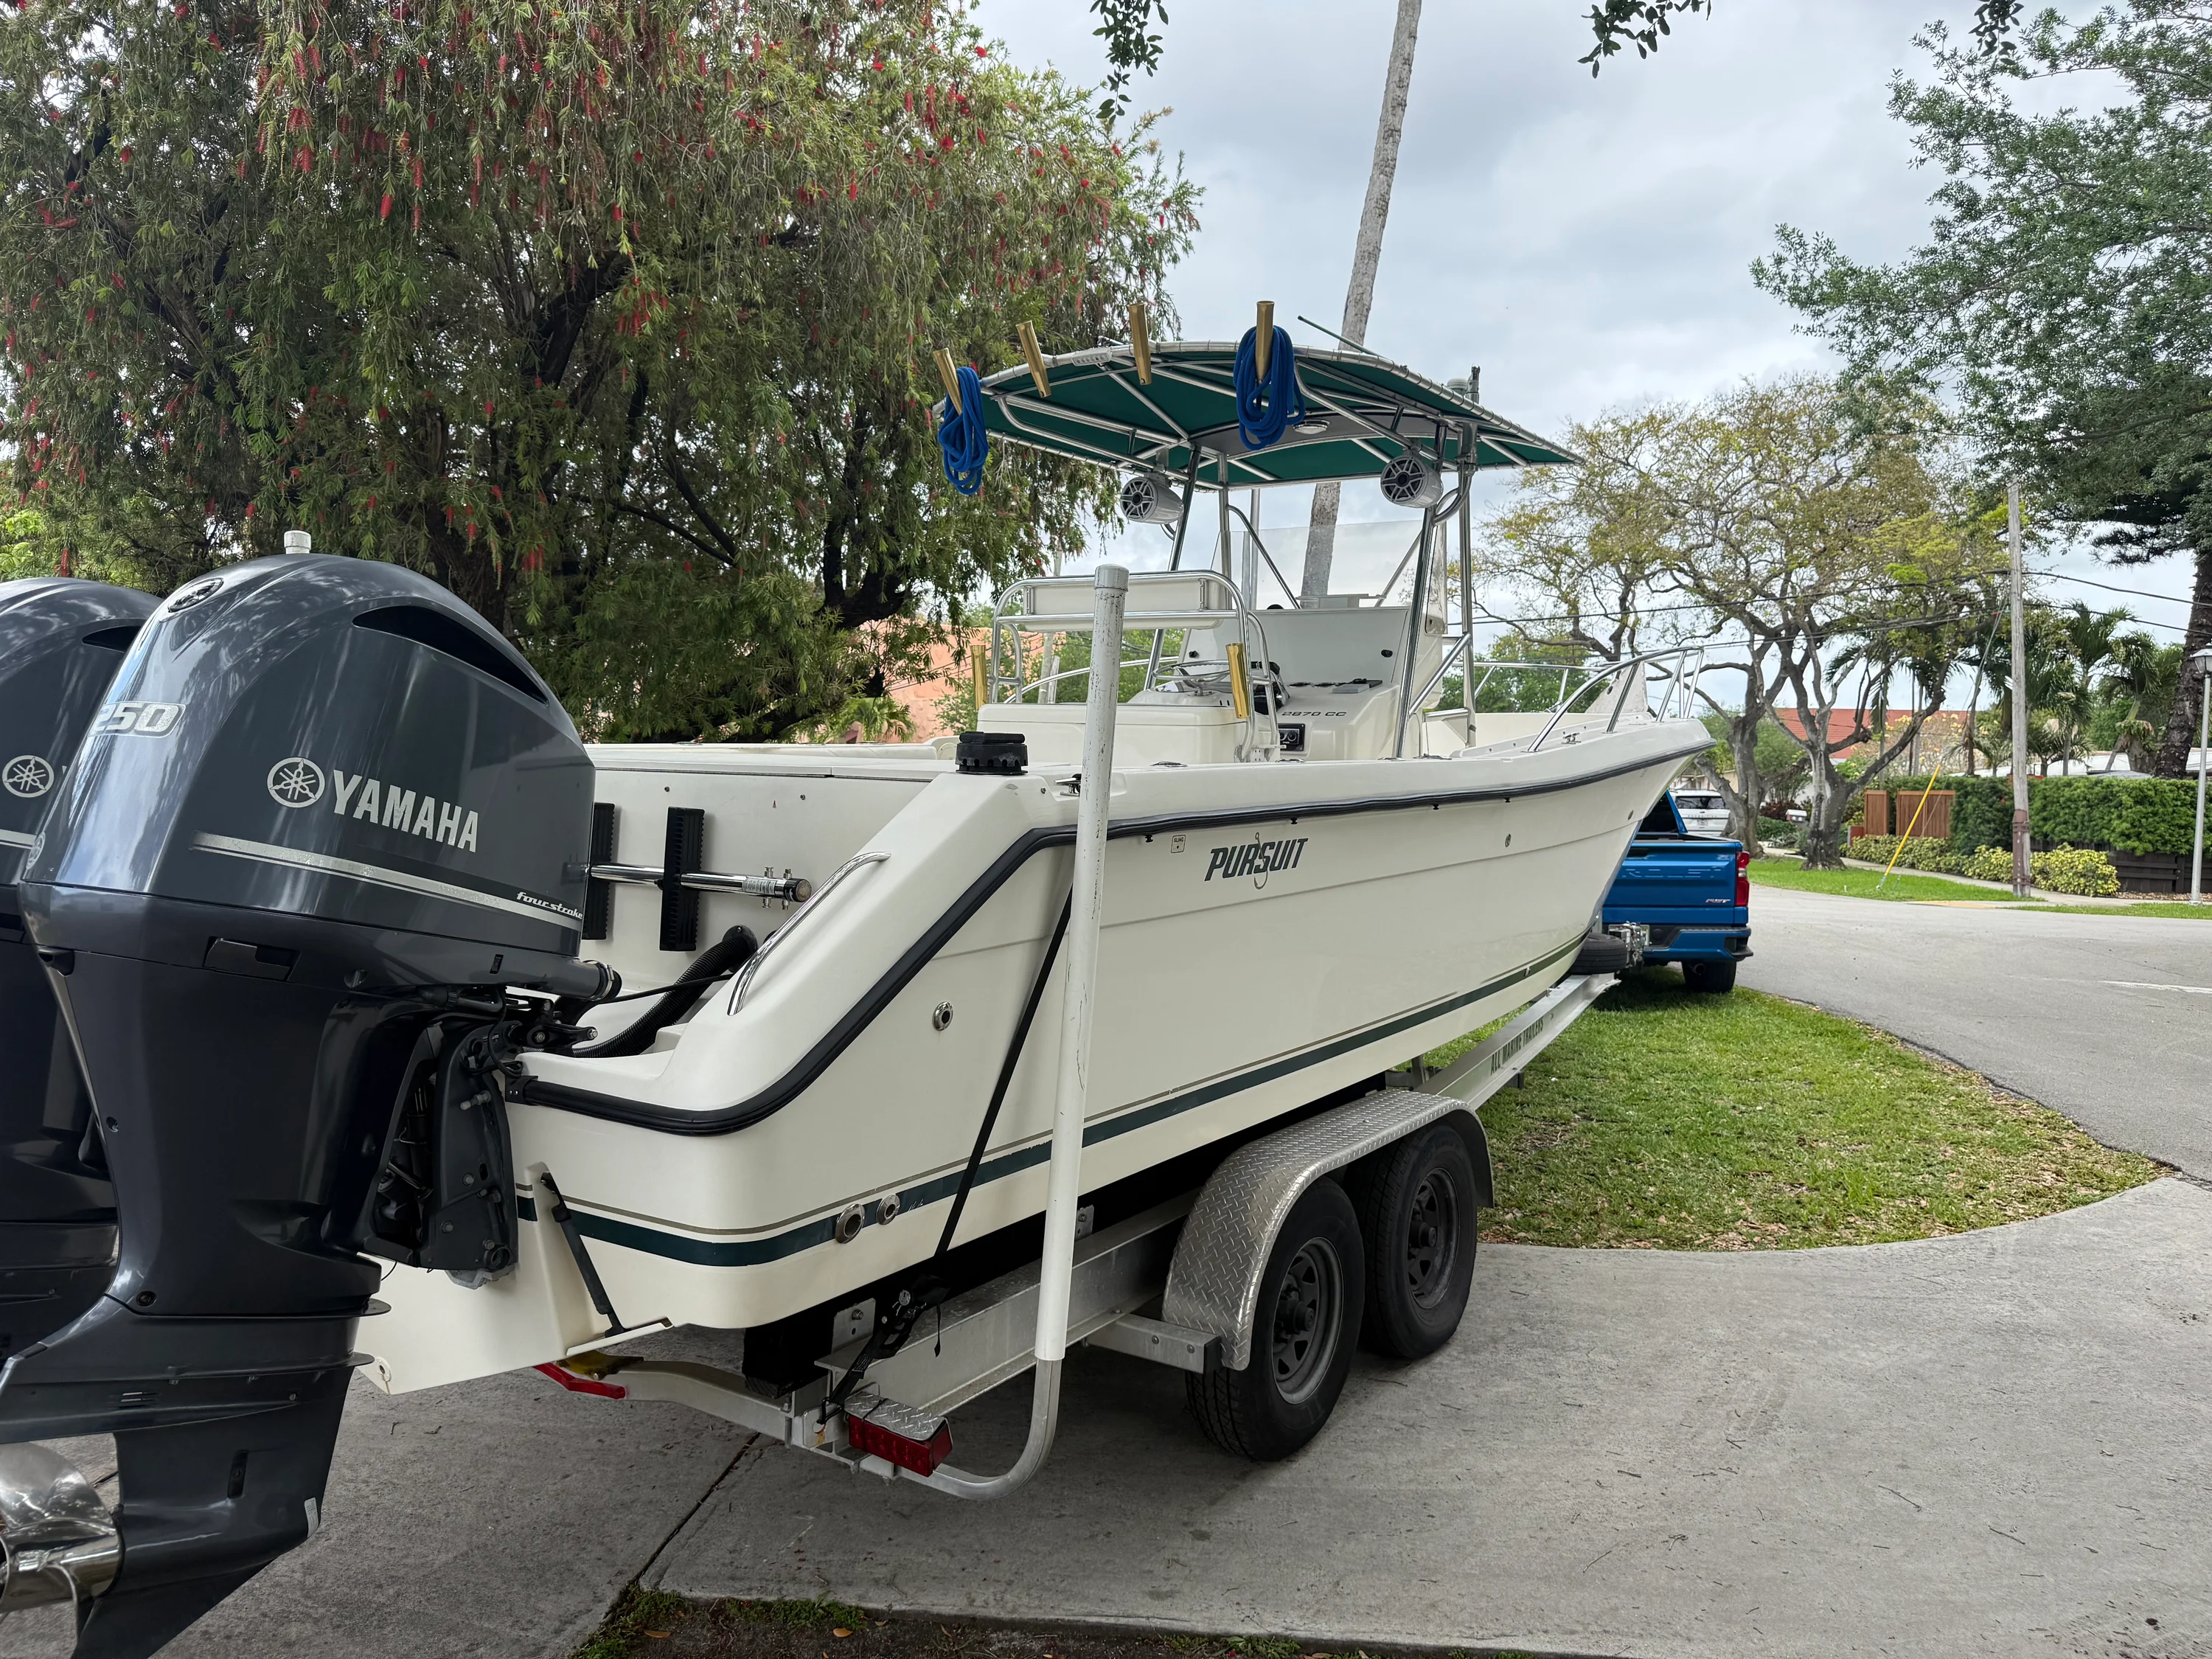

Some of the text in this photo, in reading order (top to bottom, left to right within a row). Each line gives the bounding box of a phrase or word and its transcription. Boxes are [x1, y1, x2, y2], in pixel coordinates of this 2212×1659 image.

[97, 703, 179, 733] 250
[333, 769, 479, 852] YAMAHA
[1204, 838, 1309, 882] PURSUIT
[1622, 869, 1722, 877] ROLET
[1490, 1049, 1500, 1076] ALL
[1502, 1032, 1521, 1065] MARINE
